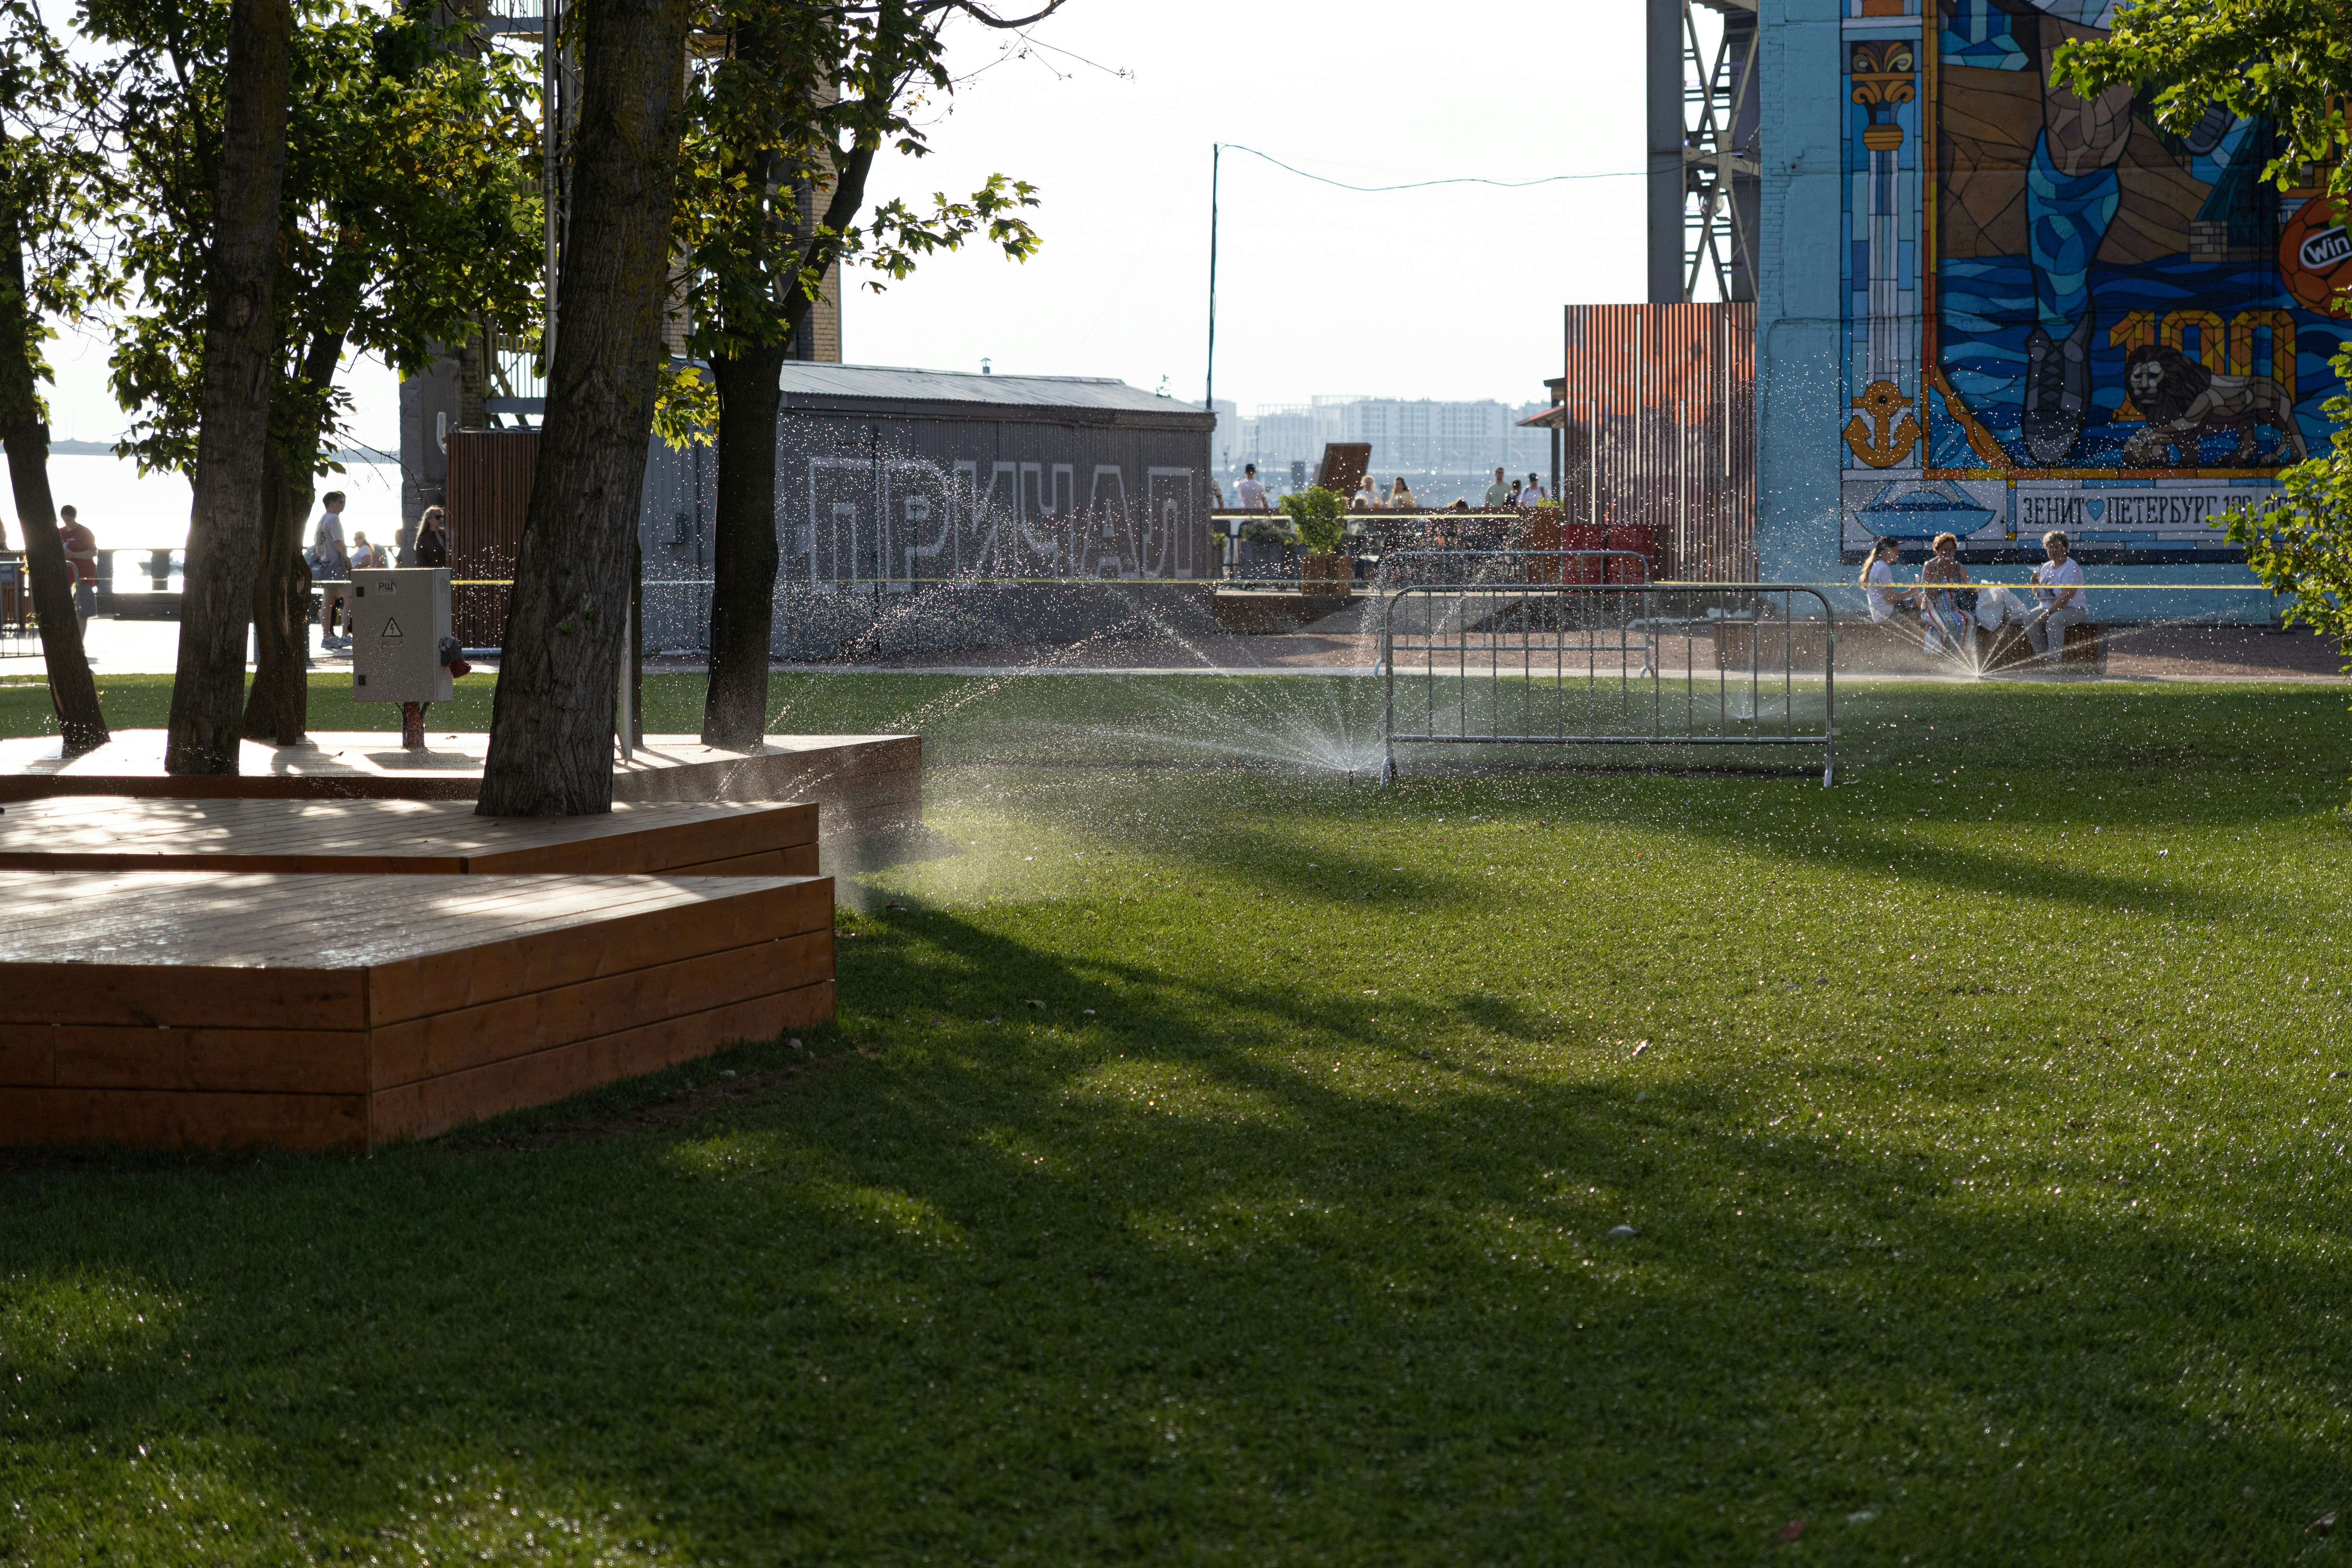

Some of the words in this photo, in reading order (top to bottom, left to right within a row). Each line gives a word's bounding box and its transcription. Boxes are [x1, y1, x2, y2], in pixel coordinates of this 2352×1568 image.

[809, 457, 1192, 594] ПРИЧАЛ
[2023, 497, 2085, 524] ЗЕНИТ
[2107, 496, 2217, 524] ПЕТЕРБУРГ
